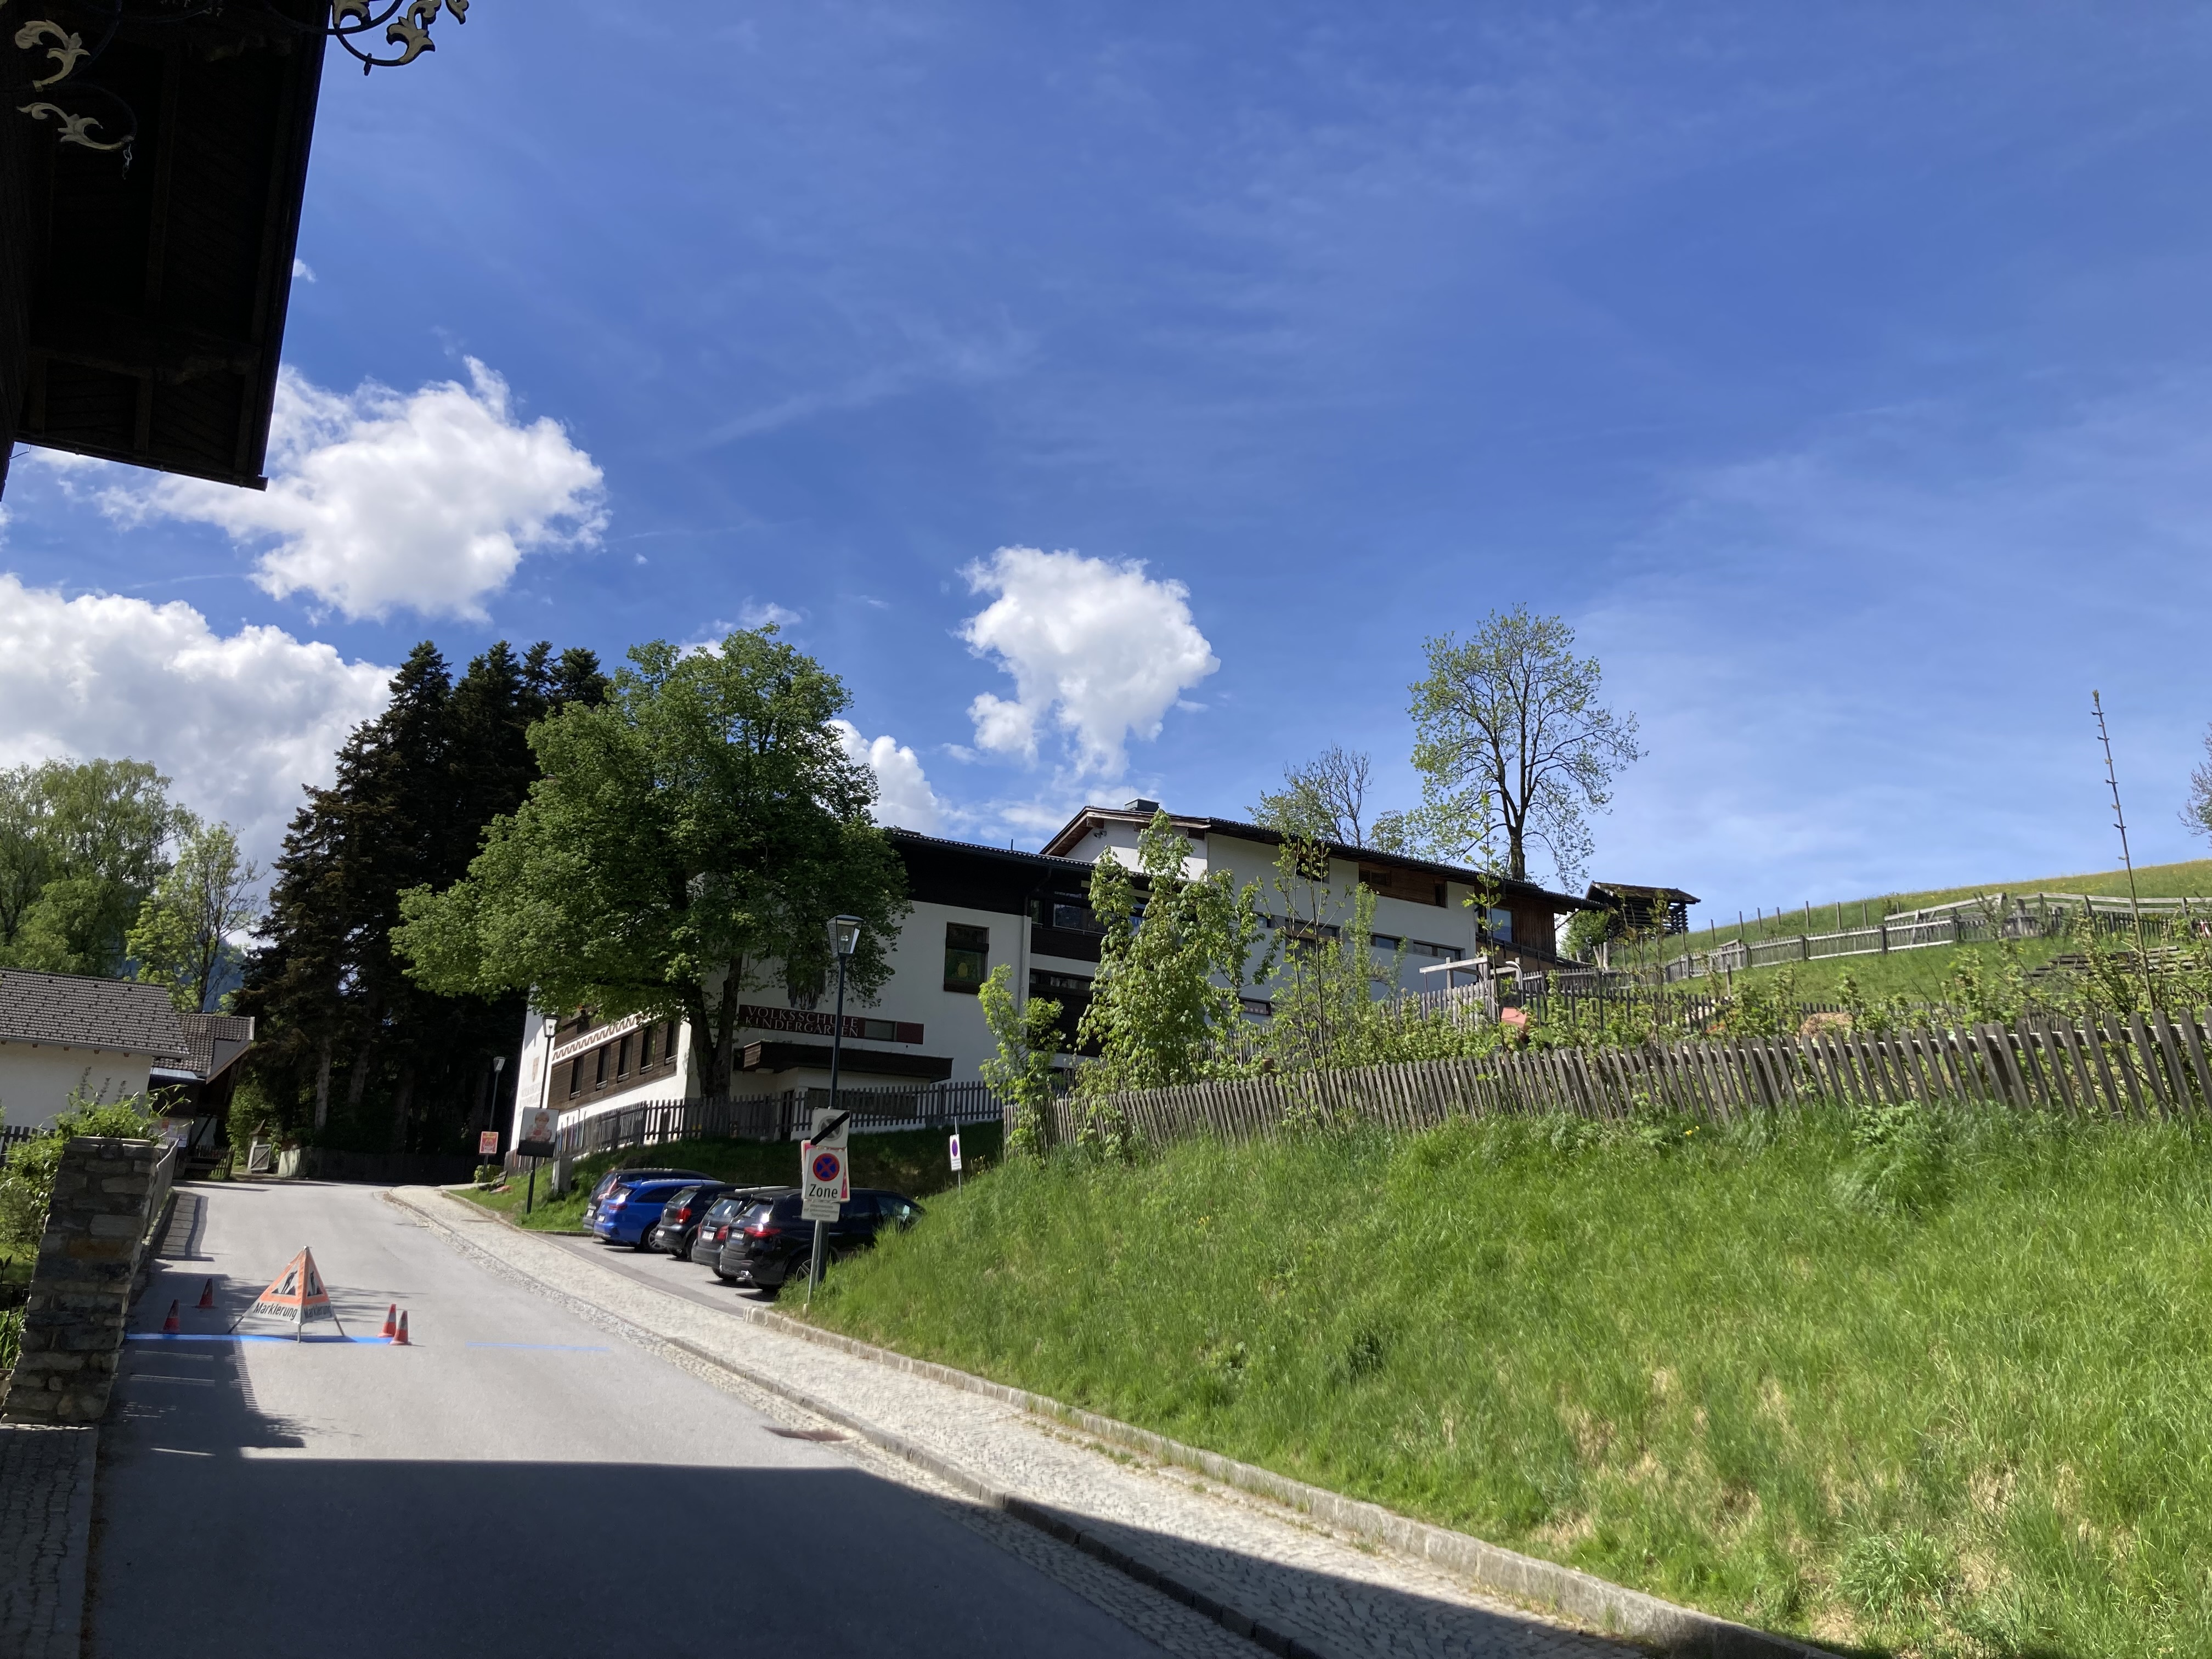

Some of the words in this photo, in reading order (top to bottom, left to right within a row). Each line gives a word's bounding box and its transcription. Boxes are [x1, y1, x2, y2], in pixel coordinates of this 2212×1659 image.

[746, 1016, 859, 1037] KINDERGAREN
[748, 1006, 859, 1028] VOLKSSCHULE
[809, 1183, 838, 1199] Zone
[253, 1302, 298, 1321] Markierung
